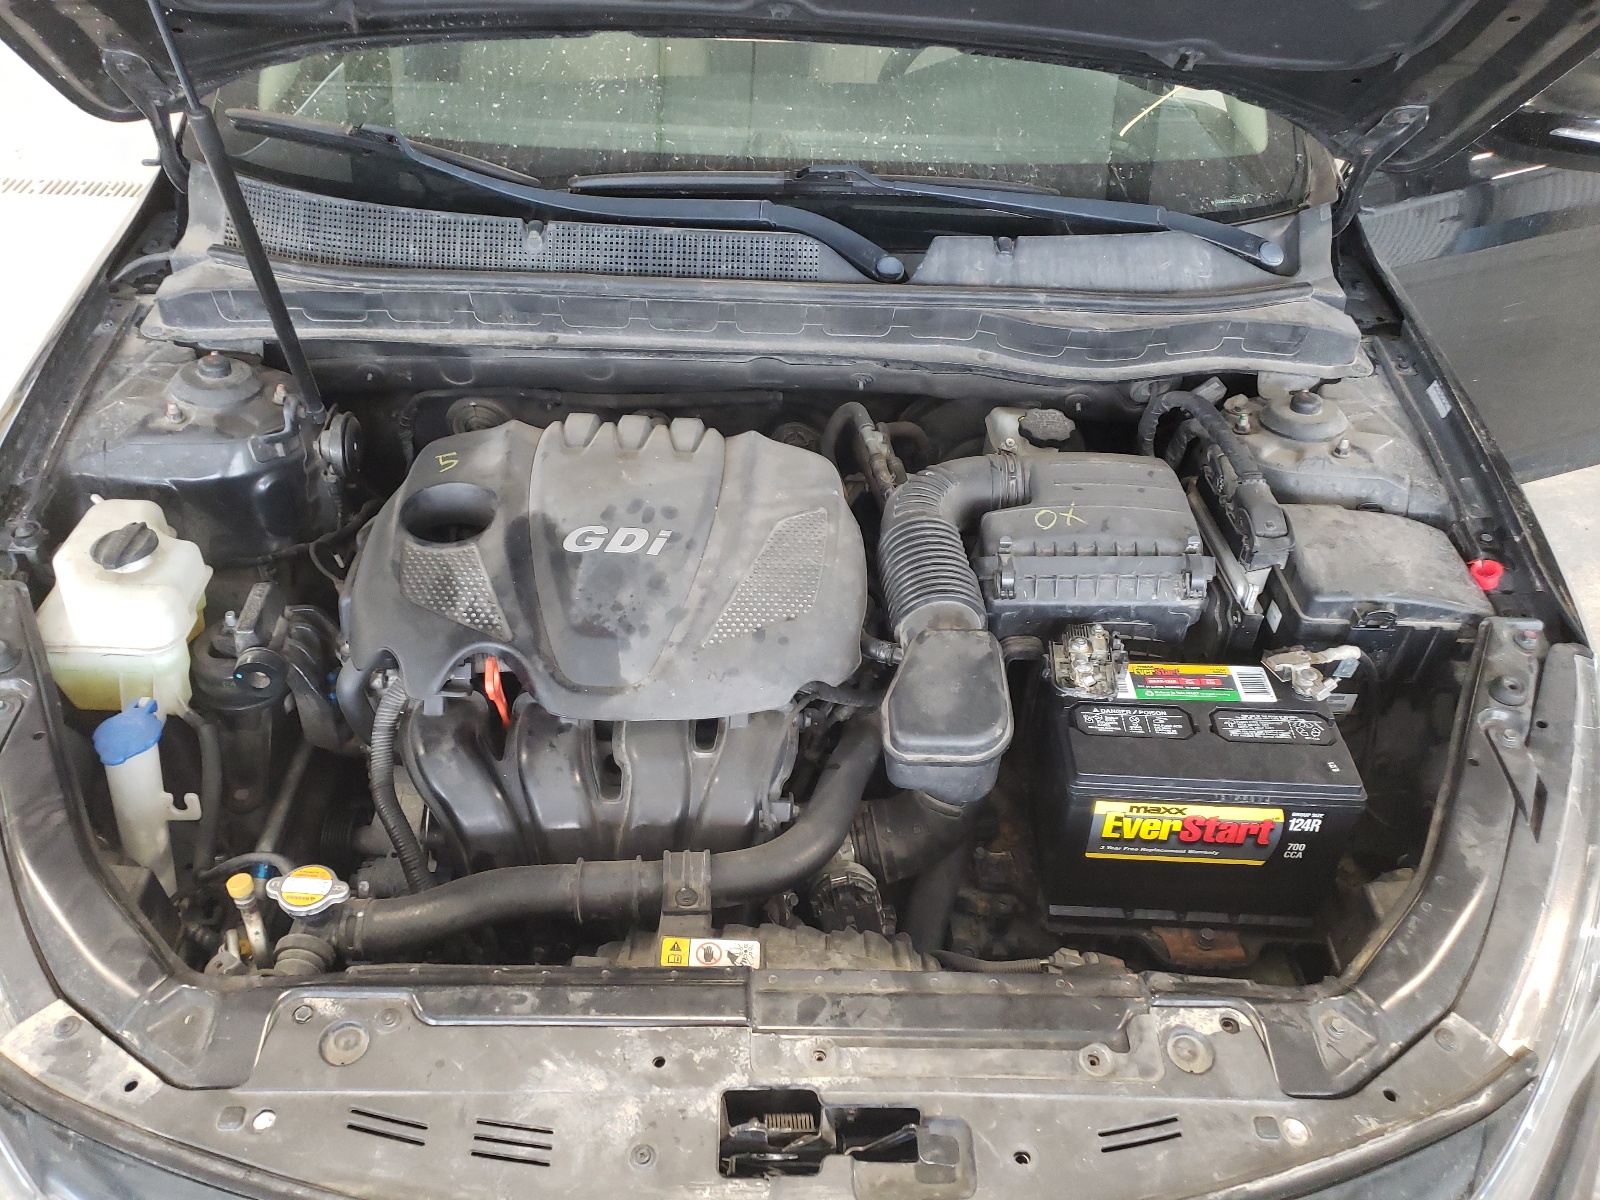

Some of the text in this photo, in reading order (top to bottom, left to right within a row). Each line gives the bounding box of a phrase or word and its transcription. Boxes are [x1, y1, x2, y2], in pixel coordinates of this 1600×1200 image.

[435, 451, 459, 473] 5
[562, 525, 674, 555] GDi
[1129, 805, 1188, 816] maxx
[1101, 811, 1276, 846] EverStart
[1288, 818, 1322, 833] 124R
[1287, 843, 1306, 851] 700
